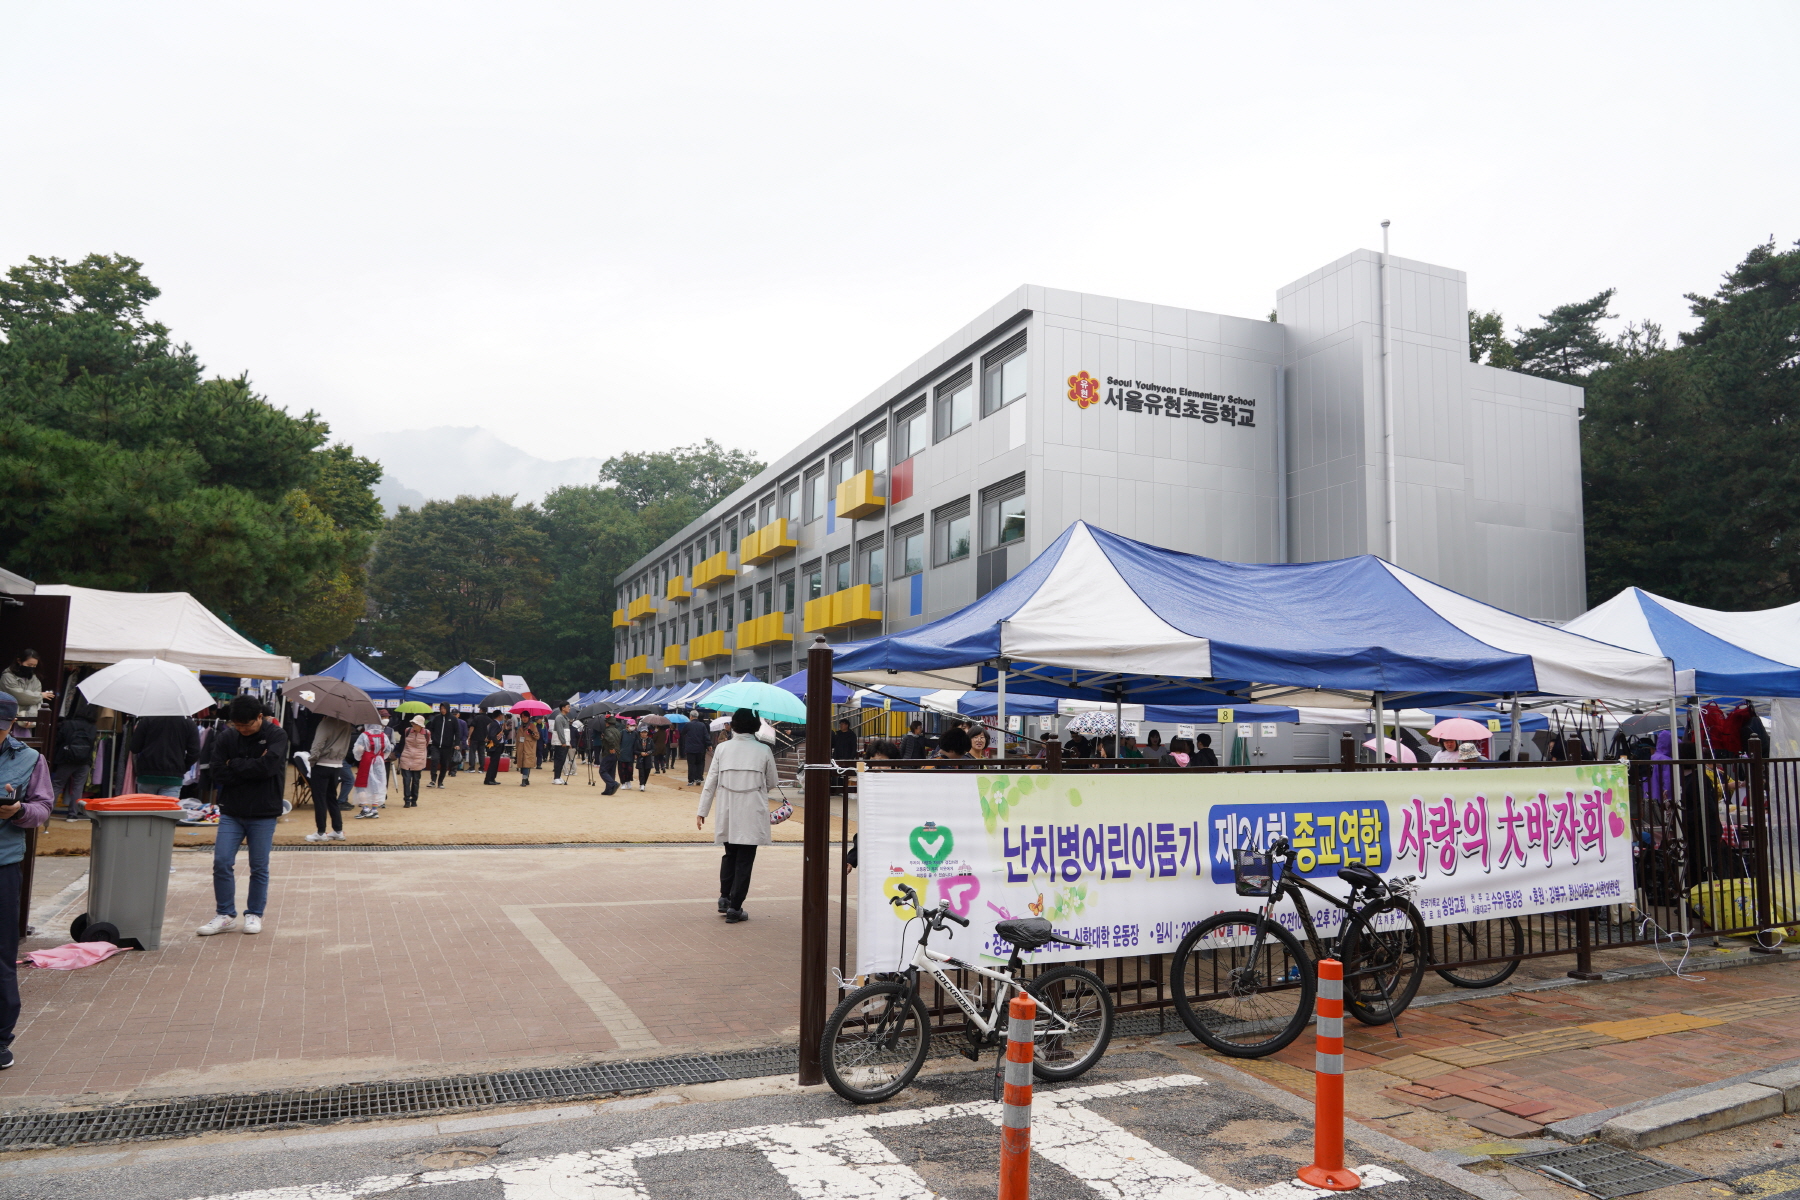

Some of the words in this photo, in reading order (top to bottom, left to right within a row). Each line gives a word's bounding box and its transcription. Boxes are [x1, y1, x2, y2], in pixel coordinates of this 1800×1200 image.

[1107, 376, 1132, 388] Seoul
[1135, 380, 1177, 395] Youhyeon
[1179, 387, 1226, 403] Elementary
[1227, 395, 1256, 407] School
[1104, 387, 1256, 428] 서울유현초등학교
[1222, 710, 1229, 720] 8
[1003, 821, 1200, 882] 난치병어린이돕기
[1293, 808, 1382, 872] 종교연합
[1398, 796, 1489, 875] 사랑의
[1491, 889, 1523, 910] 수유1동성당
[1568, 883, 1594, 902] 한신대학교
[1595, 879, 1621, 899] 신학대학원
[1112, 924, 1139, 948] 운동장
[1155, 921, 1172, 944] 일시
[933, 969, 975, 1016] ROCKRIDER
